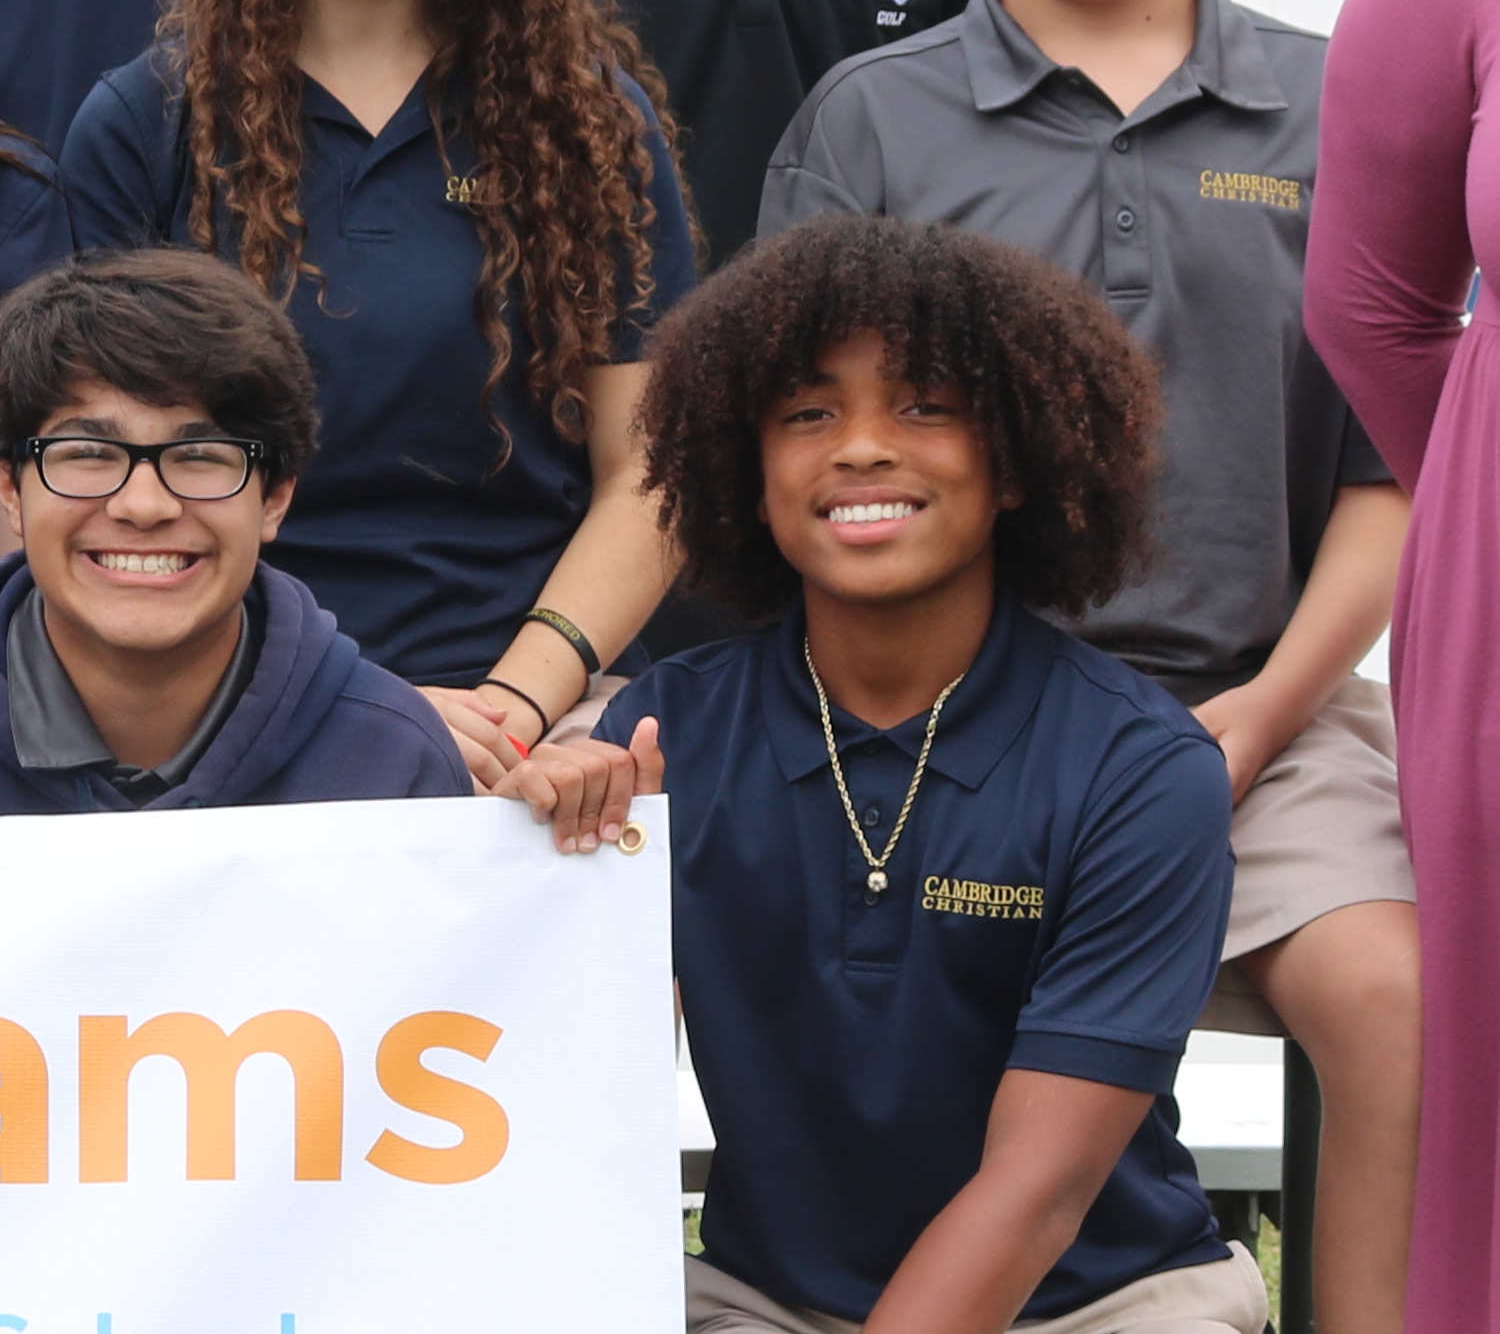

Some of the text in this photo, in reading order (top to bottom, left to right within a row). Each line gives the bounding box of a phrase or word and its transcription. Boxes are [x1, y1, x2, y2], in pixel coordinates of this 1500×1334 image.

[876, 9, 906, 26] GOLF
[1201, 170, 1300, 198] CAMBRIDGE
[1200, 186, 1300, 209] CHRISTIAN
[527, 608, 580, 641] NCHORED
[924, 875, 1044, 906] CAMBRIDGE
[921, 896, 1044, 919] CHRISTIAN
